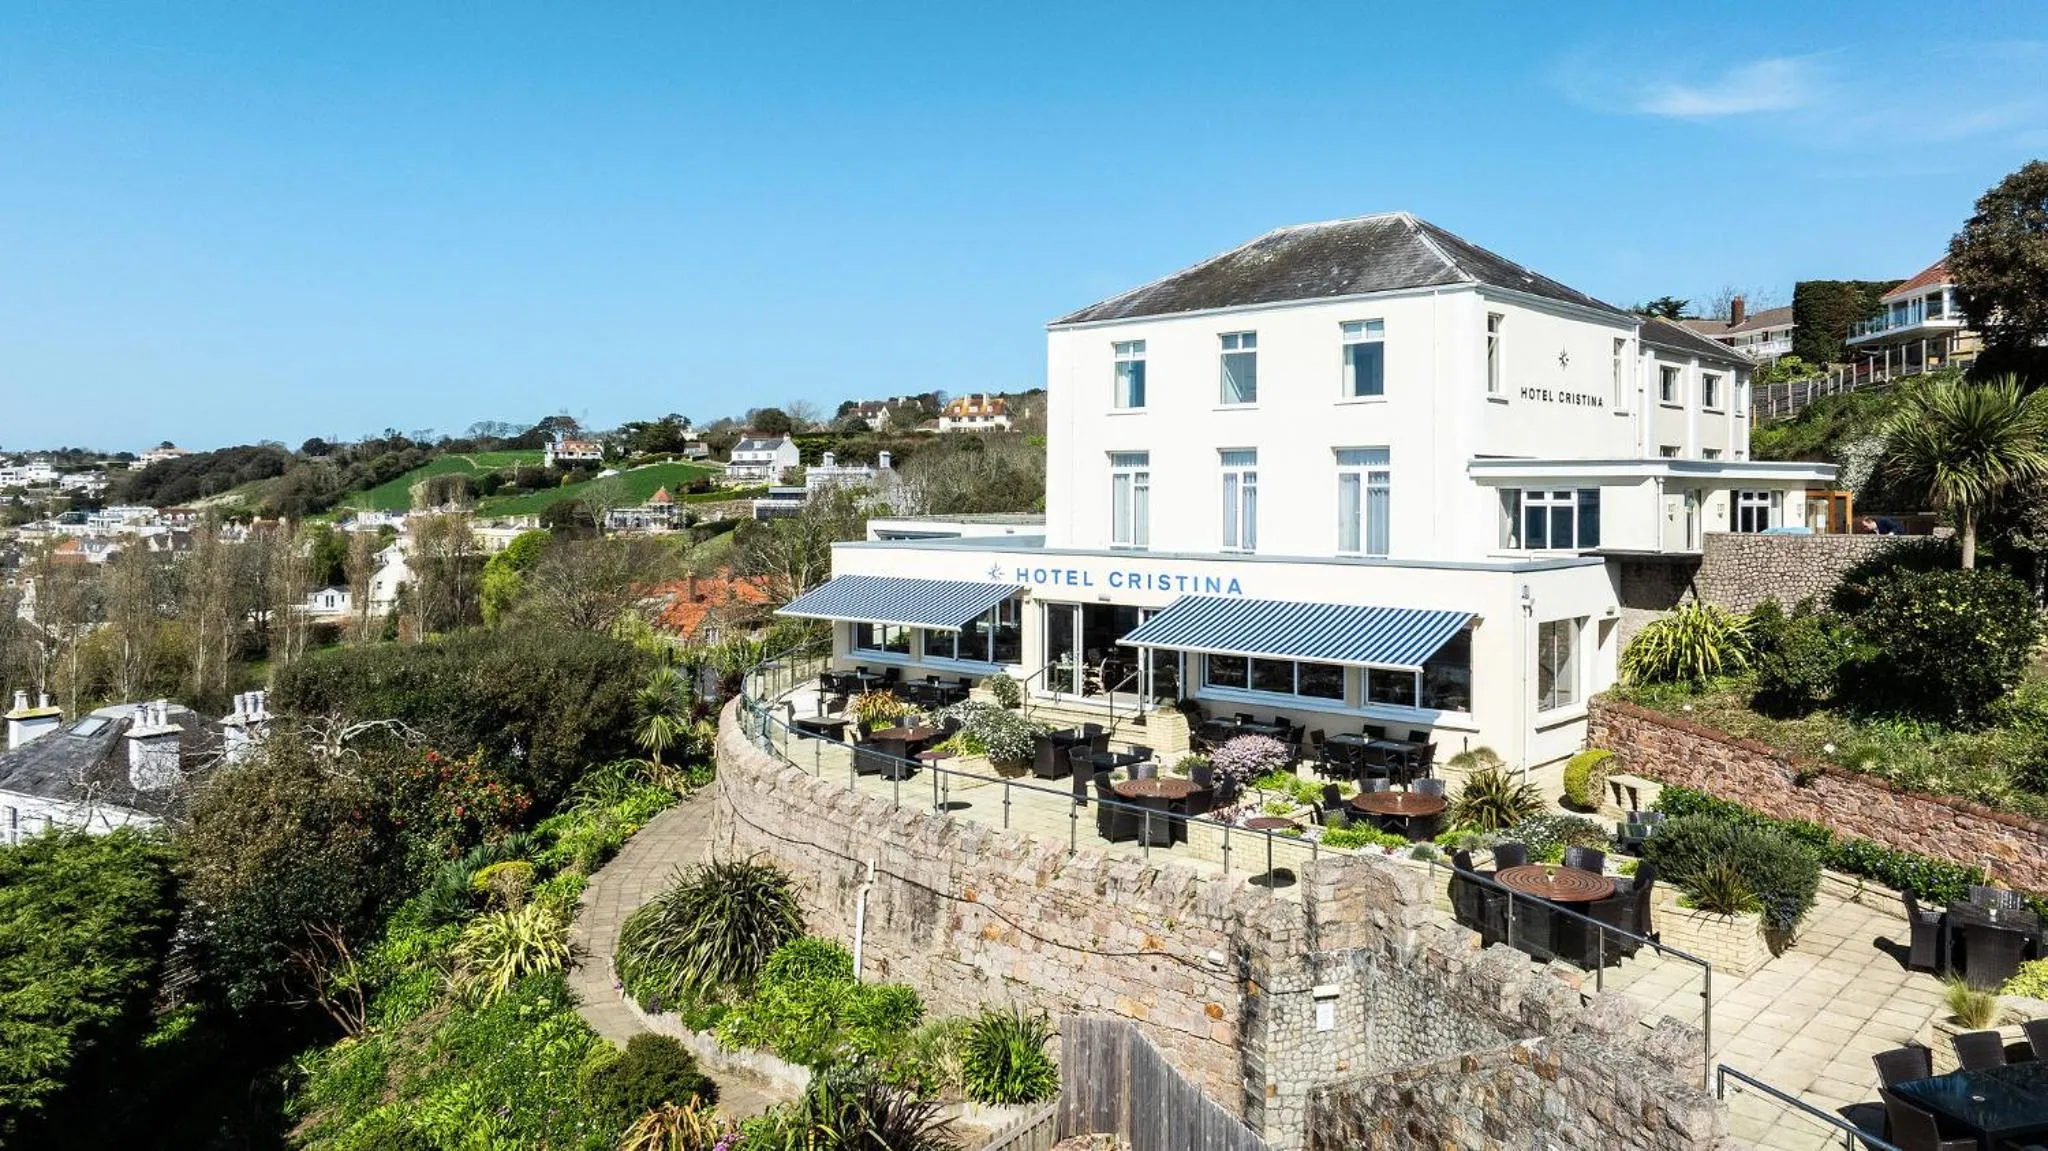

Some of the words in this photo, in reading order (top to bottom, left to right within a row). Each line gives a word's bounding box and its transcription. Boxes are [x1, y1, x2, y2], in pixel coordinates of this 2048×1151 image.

[1520, 386, 1554, 402] HOTEL
[1558, 391, 1604, 407] CRISTINA
[1016, 567, 1094, 587] HOTEL
[1109, 571, 1243, 595] CRISTINA
